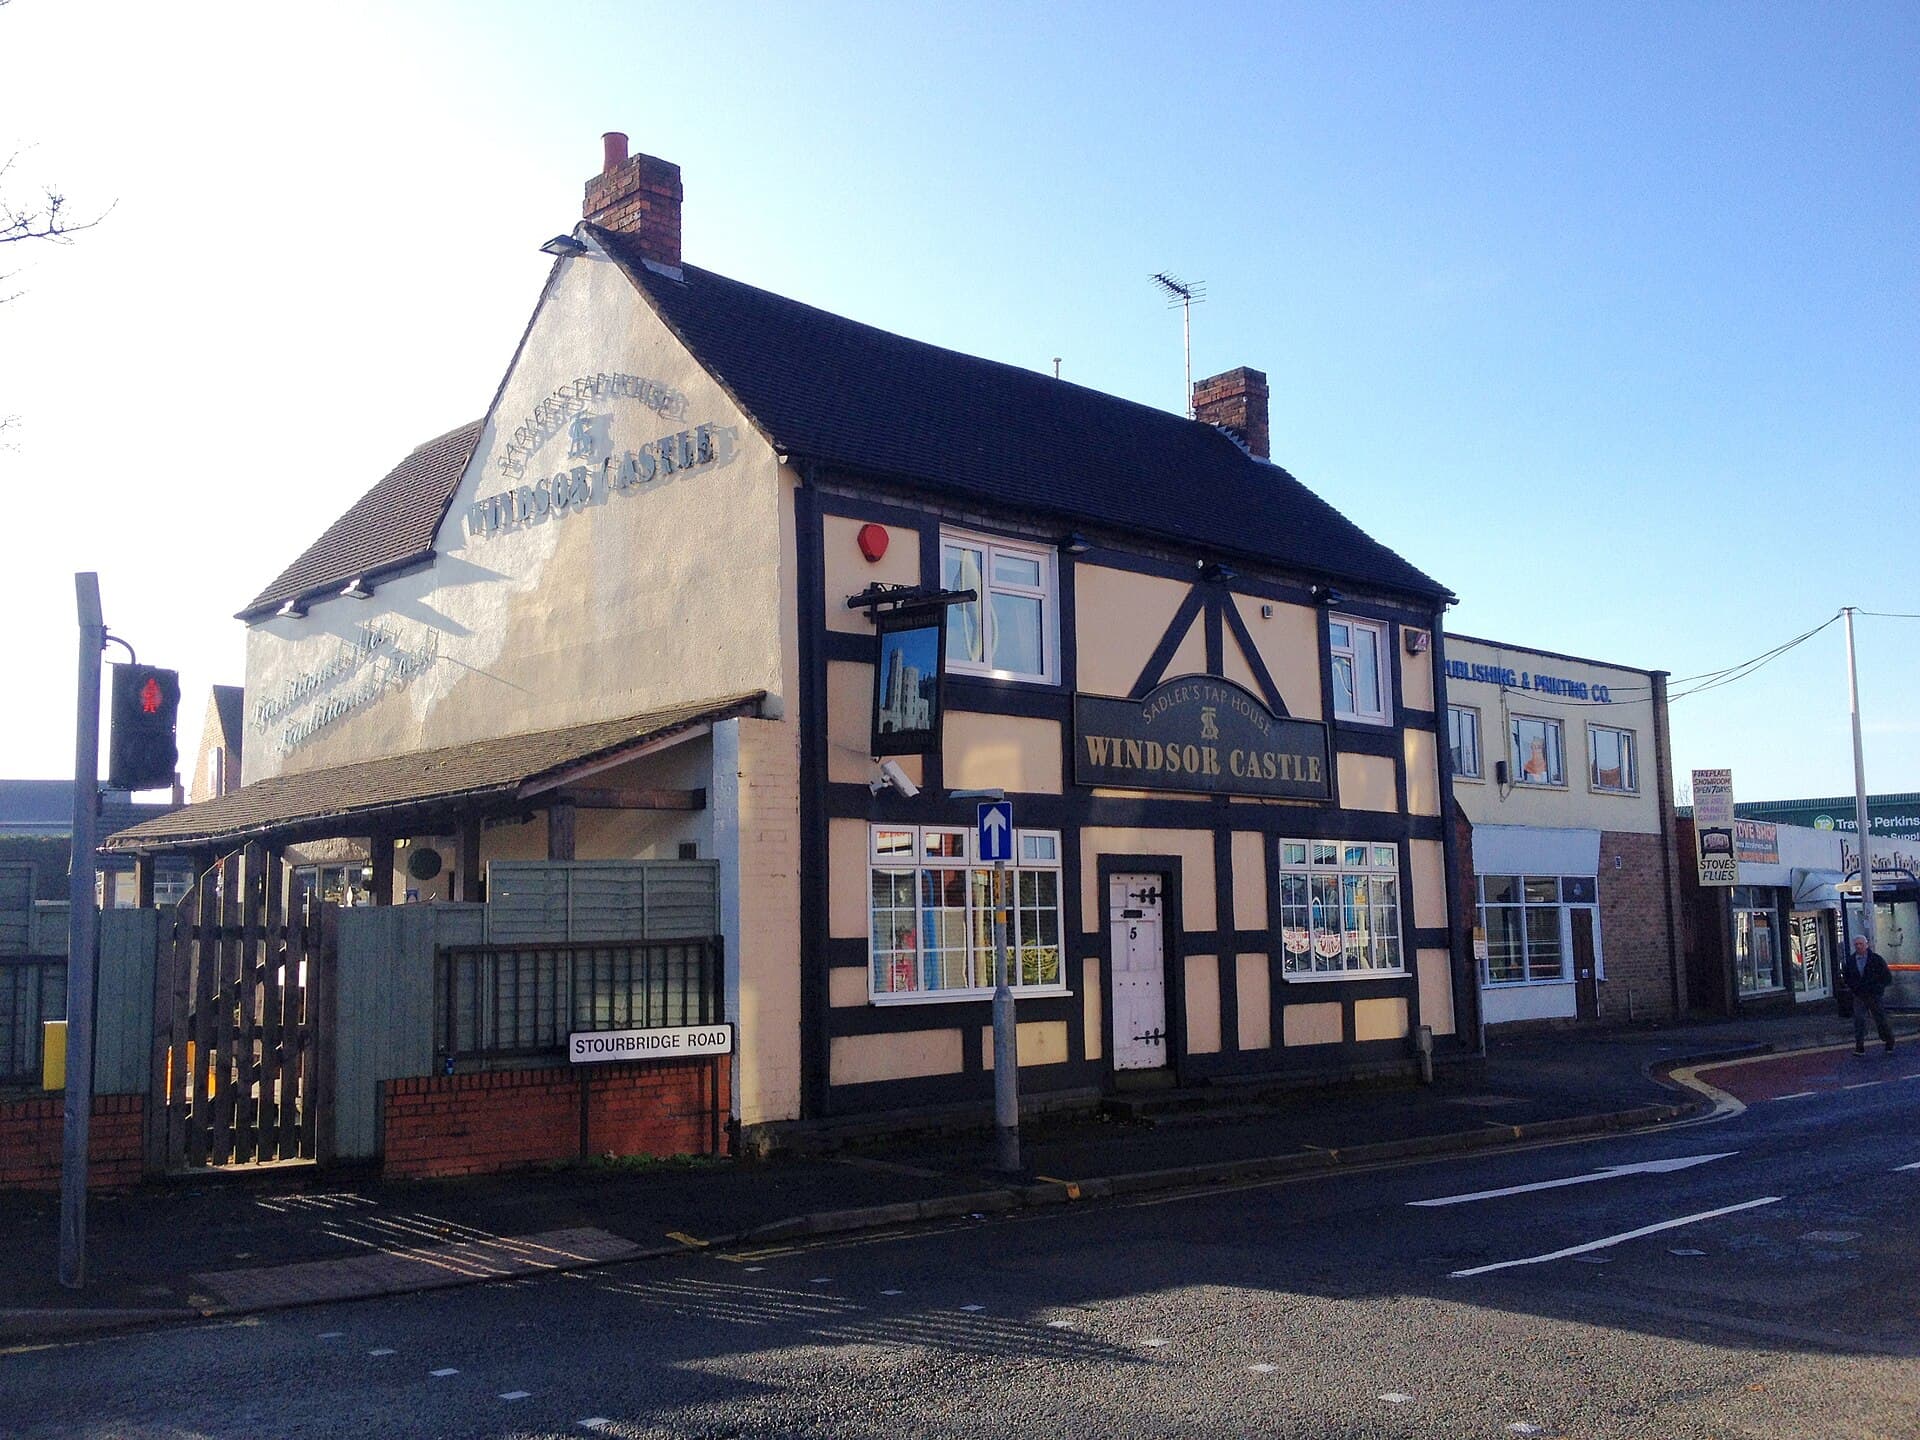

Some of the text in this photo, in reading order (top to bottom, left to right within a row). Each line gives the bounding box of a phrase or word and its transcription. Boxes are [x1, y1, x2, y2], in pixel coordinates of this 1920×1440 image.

[1522, 671, 1530, 690] &
[1534, 674, 1588, 700] PRINTING
[1592, 684, 1612, 703] CO.
[1142, 685, 1201, 725] SADLER'S
[1204, 686, 1228, 703] TAP
[1231, 695, 1273, 737] HOUSE
[1084, 735, 1321, 783] WINDSOR CASTLE
[1836, 815, 1920, 829] Travs Perkins
[1700, 859, 1736, 870] STOVES
[1703, 870, 1734, 881] FLUES
[1129, 927, 1138, 940] 5
[575, 1031, 726, 1054] STOURBRIDGE ROAD
